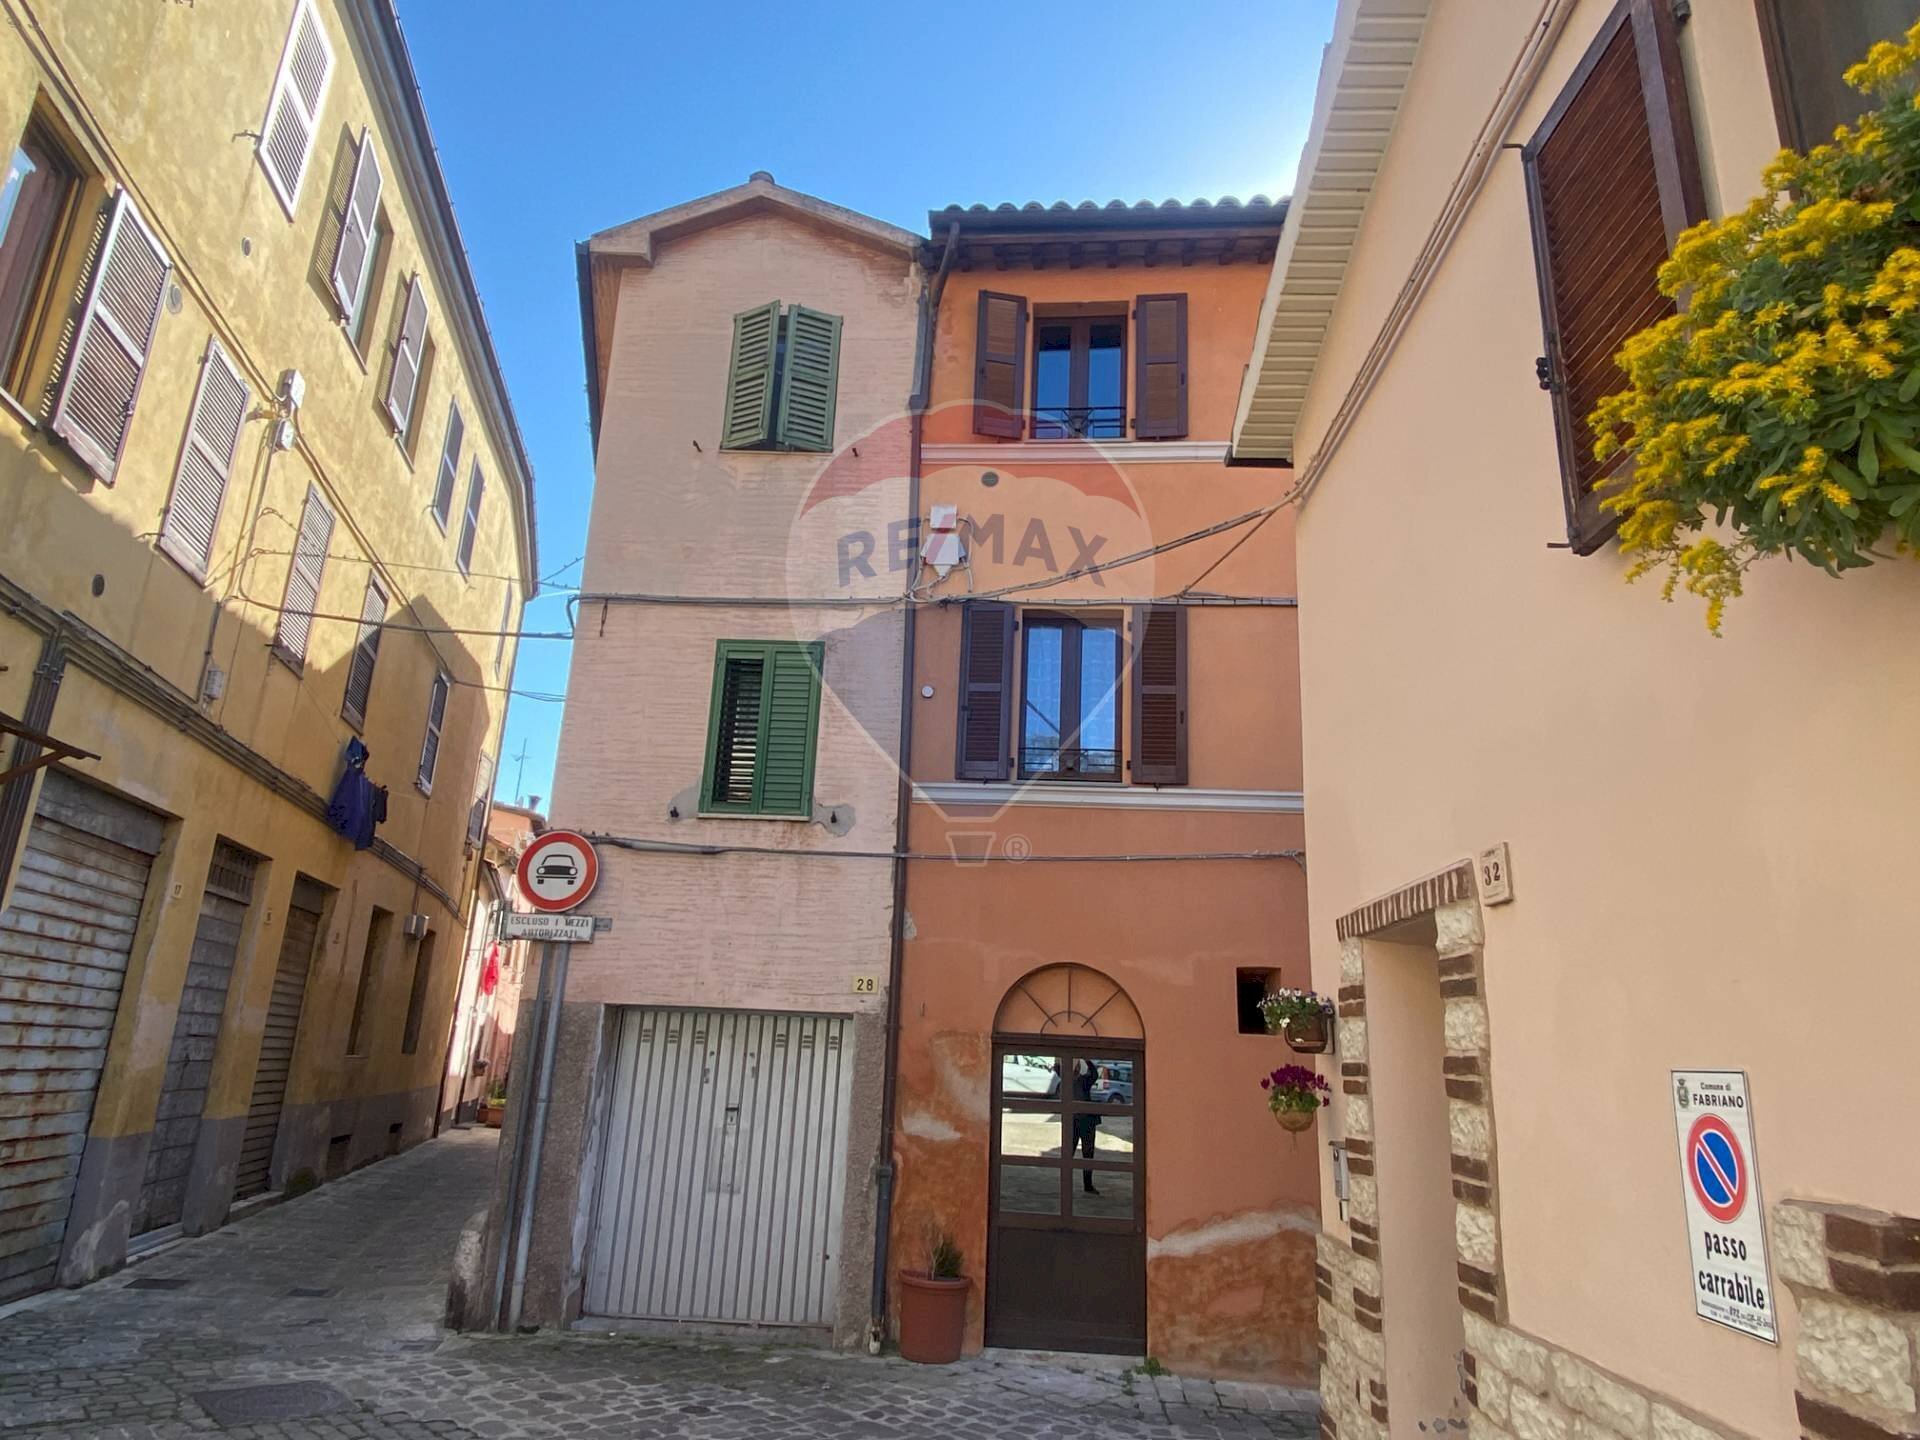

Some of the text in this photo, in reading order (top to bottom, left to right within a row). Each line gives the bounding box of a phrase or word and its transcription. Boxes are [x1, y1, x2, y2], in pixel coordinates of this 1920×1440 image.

[1484, 862, 1500, 886] 32
[510, 916, 549, 926] ESCLUSO
[565, 918, 589, 927] MEZZI
[520, 928, 578, 938] AUTORIZZATI
[857, 978, 873, 991] 28
[1700, 1082, 1723, 1090] Comune
[1693, 1093, 1744, 1108] FABRIANO
[1704, 1231, 1747, 1261] passo
[1698, 1270, 1765, 1310] carrabile
